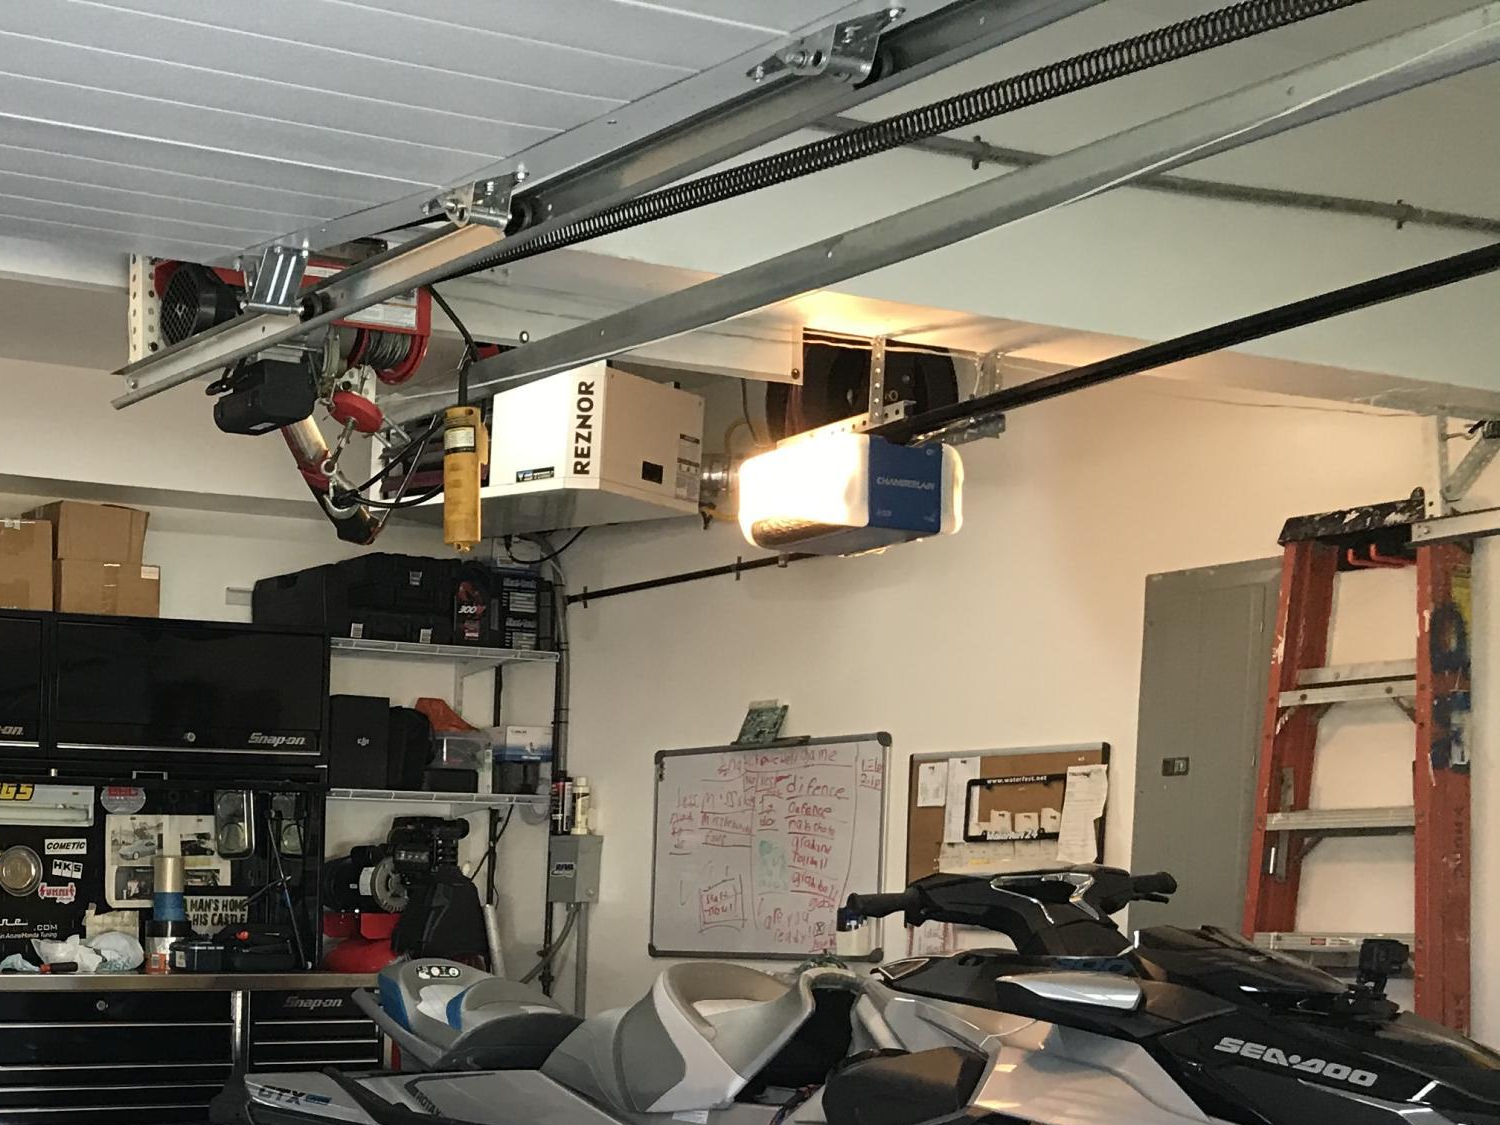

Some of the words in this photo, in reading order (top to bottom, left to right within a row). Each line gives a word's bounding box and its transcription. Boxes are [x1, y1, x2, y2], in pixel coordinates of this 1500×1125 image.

[573, 381, 595, 475] REZNOR
[248, 732, 306, 747] Snap-on
[46, 841, 86, 850] COMETIC
[52, 860, 82, 873] HKS
[190, 898, 219, 912] MAN'S
[221, 899, 247, 912] HOME
[192, 913, 209, 926] HIS
[211, 913, 245, 926] CASTLE
[284, 996, 342, 1009] Snap-on
